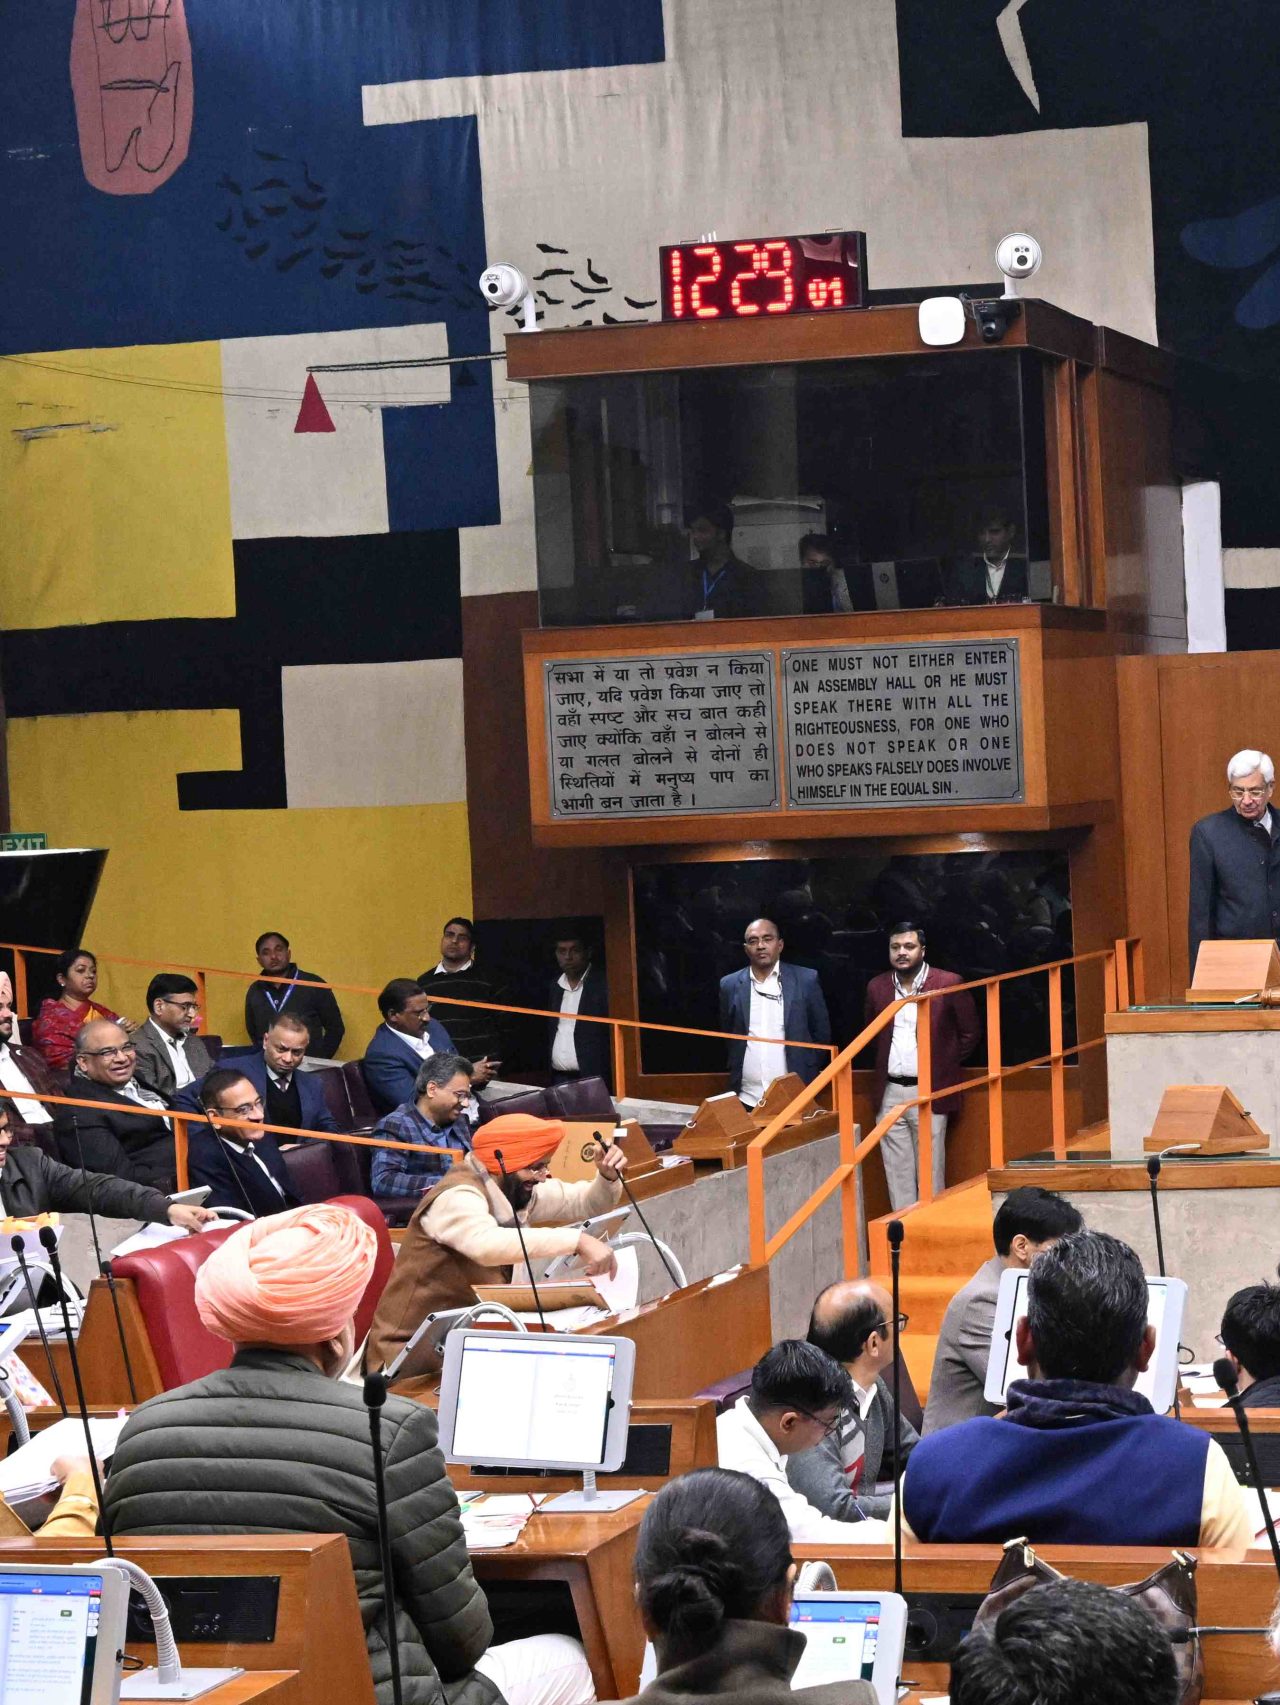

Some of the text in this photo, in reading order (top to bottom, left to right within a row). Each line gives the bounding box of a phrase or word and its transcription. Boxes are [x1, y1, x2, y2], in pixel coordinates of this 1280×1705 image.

[553, 659, 764, 684] सभा में या तो प्रवेश न किया
[792, 650, 1006, 673] ONE MUST NOT EITHER ENTER
[596, 686, 623, 703] यदि
[628, 684, 663, 702] प्रवेश
[668, 683, 706, 700] किया
[711, 684, 743, 699] जाए
[748, 679, 766, 696] तो
[793, 672, 1008, 694] AN ASSEMBLY HALL OR HE MUST
[556, 699, 766, 726] वहाँ स्पष्ट और सच बात कही
[794, 693, 1008, 715] SPEAK THERE WITH ALL THE
[556, 721, 768, 748] जाए क्योंकि वहाँ न बोलने से
[795, 714, 1009, 736] RIGHTEOUSNESS, FOR ONE WHO
[558, 743, 768, 769] या गलत बोलने से दोनों ही
[795, 736, 1010, 757] DOES NOT SPEAK OR ONE
[796, 757, 1012, 778] WHO SPEAKS FALSELY DOES INVOLVE
[559, 769, 769, 790] स्थितियों में मनुष्य पाप का
[798, 784, 846, 799] HIMSELF
[850, 784, 861, 797] IN
[864, 783, 887, 796] THE
[890, 782, 930, 796] EQUAL
[561, 793, 594, 810] भागी
[599, 796, 624, 809] बन
[628, 795, 665, 808] जाता
[671, 790, 683, 807] है
[2, 838, 44, 850] EXIT
